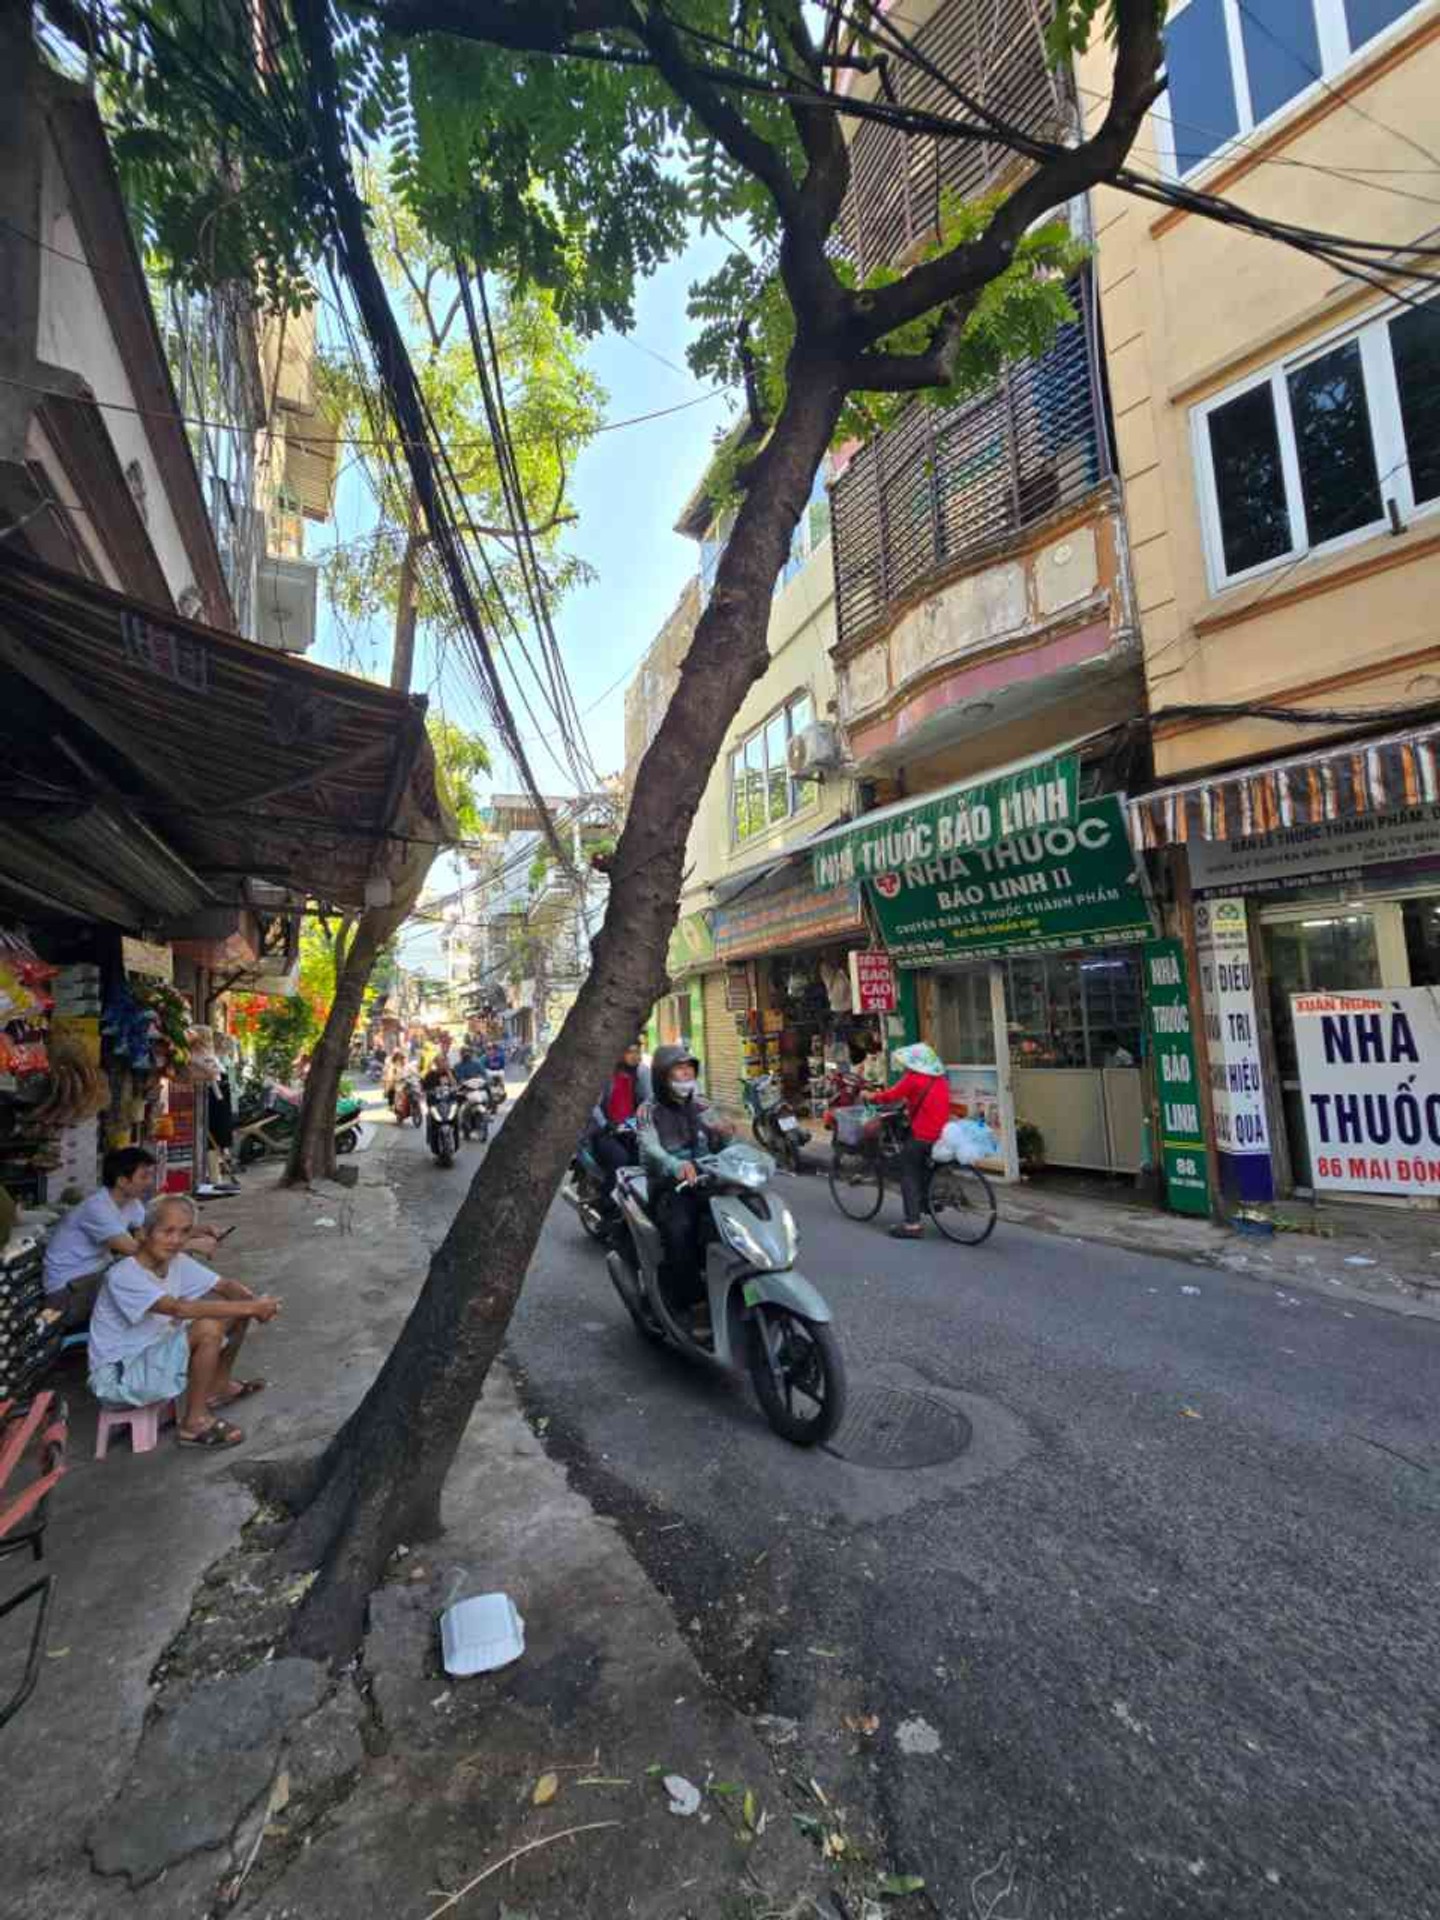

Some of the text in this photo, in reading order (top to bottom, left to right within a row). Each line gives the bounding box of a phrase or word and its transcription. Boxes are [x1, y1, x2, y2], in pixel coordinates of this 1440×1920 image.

[938, 799, 991, 852] BẢO
[1001, 778, 1070, 836] LINH
[988, 871, 1049, 902] LINH
[1151, 950, 1181, 985] NHÀ
[862, 982, 892, 996] CAO
[1152, 993, 1190, 1033] THUỐC
[1227, 1013, 1252, 1048] TRỊ
[1321, 1001, 1420, 1064] NHÀ
[1161, 1044, 1191, 1082] BẢO
[1164, 1103, 1200, 1134] LINH
[1235, 1104, 1266, 1145] QUẢ
[1317, 1157, 1342, 1178] 86
[1347, 1157, 1392, 1182] MAI
